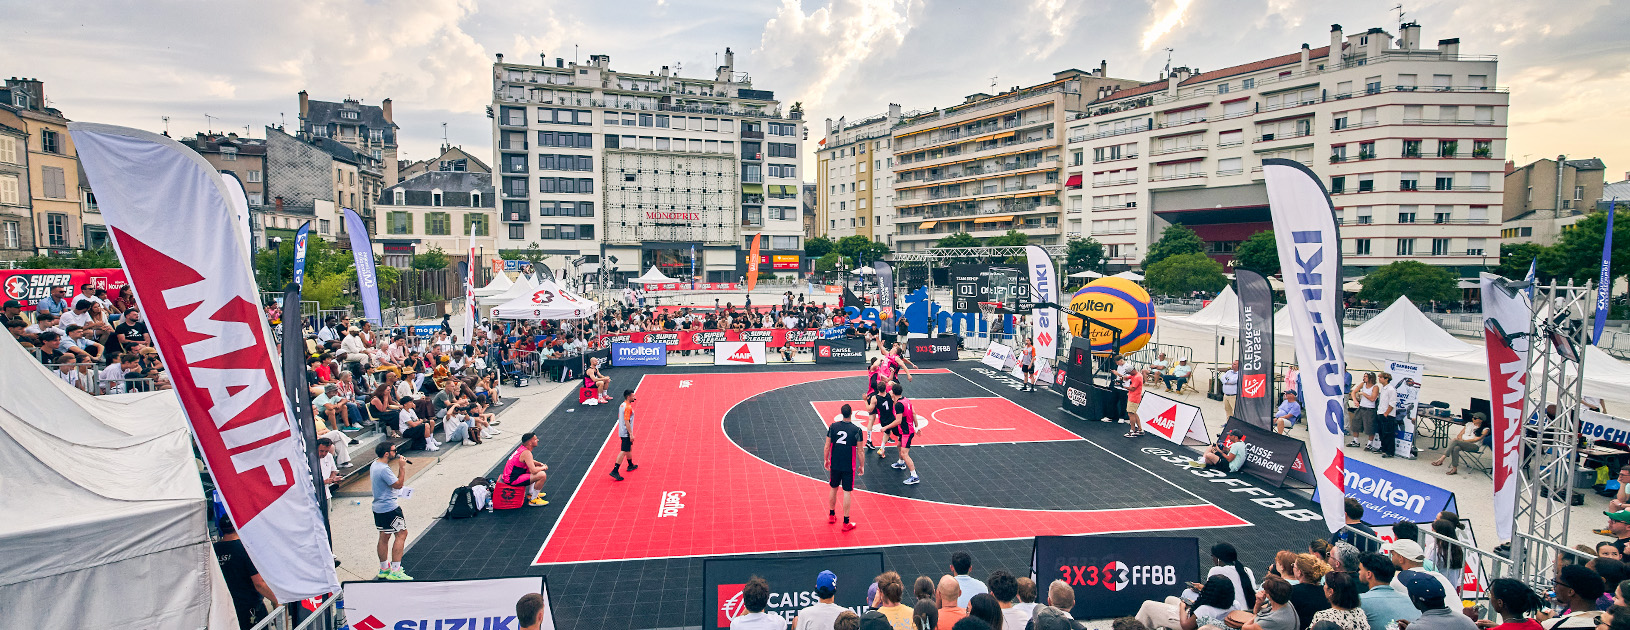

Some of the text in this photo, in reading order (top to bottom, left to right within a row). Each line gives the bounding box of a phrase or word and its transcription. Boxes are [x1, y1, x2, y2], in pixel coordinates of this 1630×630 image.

[646, 212, 700, 220] MONOPRIX
[31, 275, 71, 286] SUPER
[29, 286, 74, 299] LEAE
[961, 285, 974, 295] 01
[1071, 300, 1114, 313] molten
[619, 347, 660, 356] molten
[161, 281, 294, 487] MAIF
[882, 400, 890, 411] 1
[1152, 415, 1175, 430] MAIF
[836, 431, 848, 445] 2
[1245, 442, 1274, 460] CAISSE
[1246, 452, 1285, 474] 'EPARGNE
[1343, 468, 1426, 514] molten
[1361, 500, 1385, 514] real
[1059, 565, 1177, 586] 3X3 FFBB
[767, 591, 821, 608] CAISS
[394, 615, 520, 630] SUZUK
